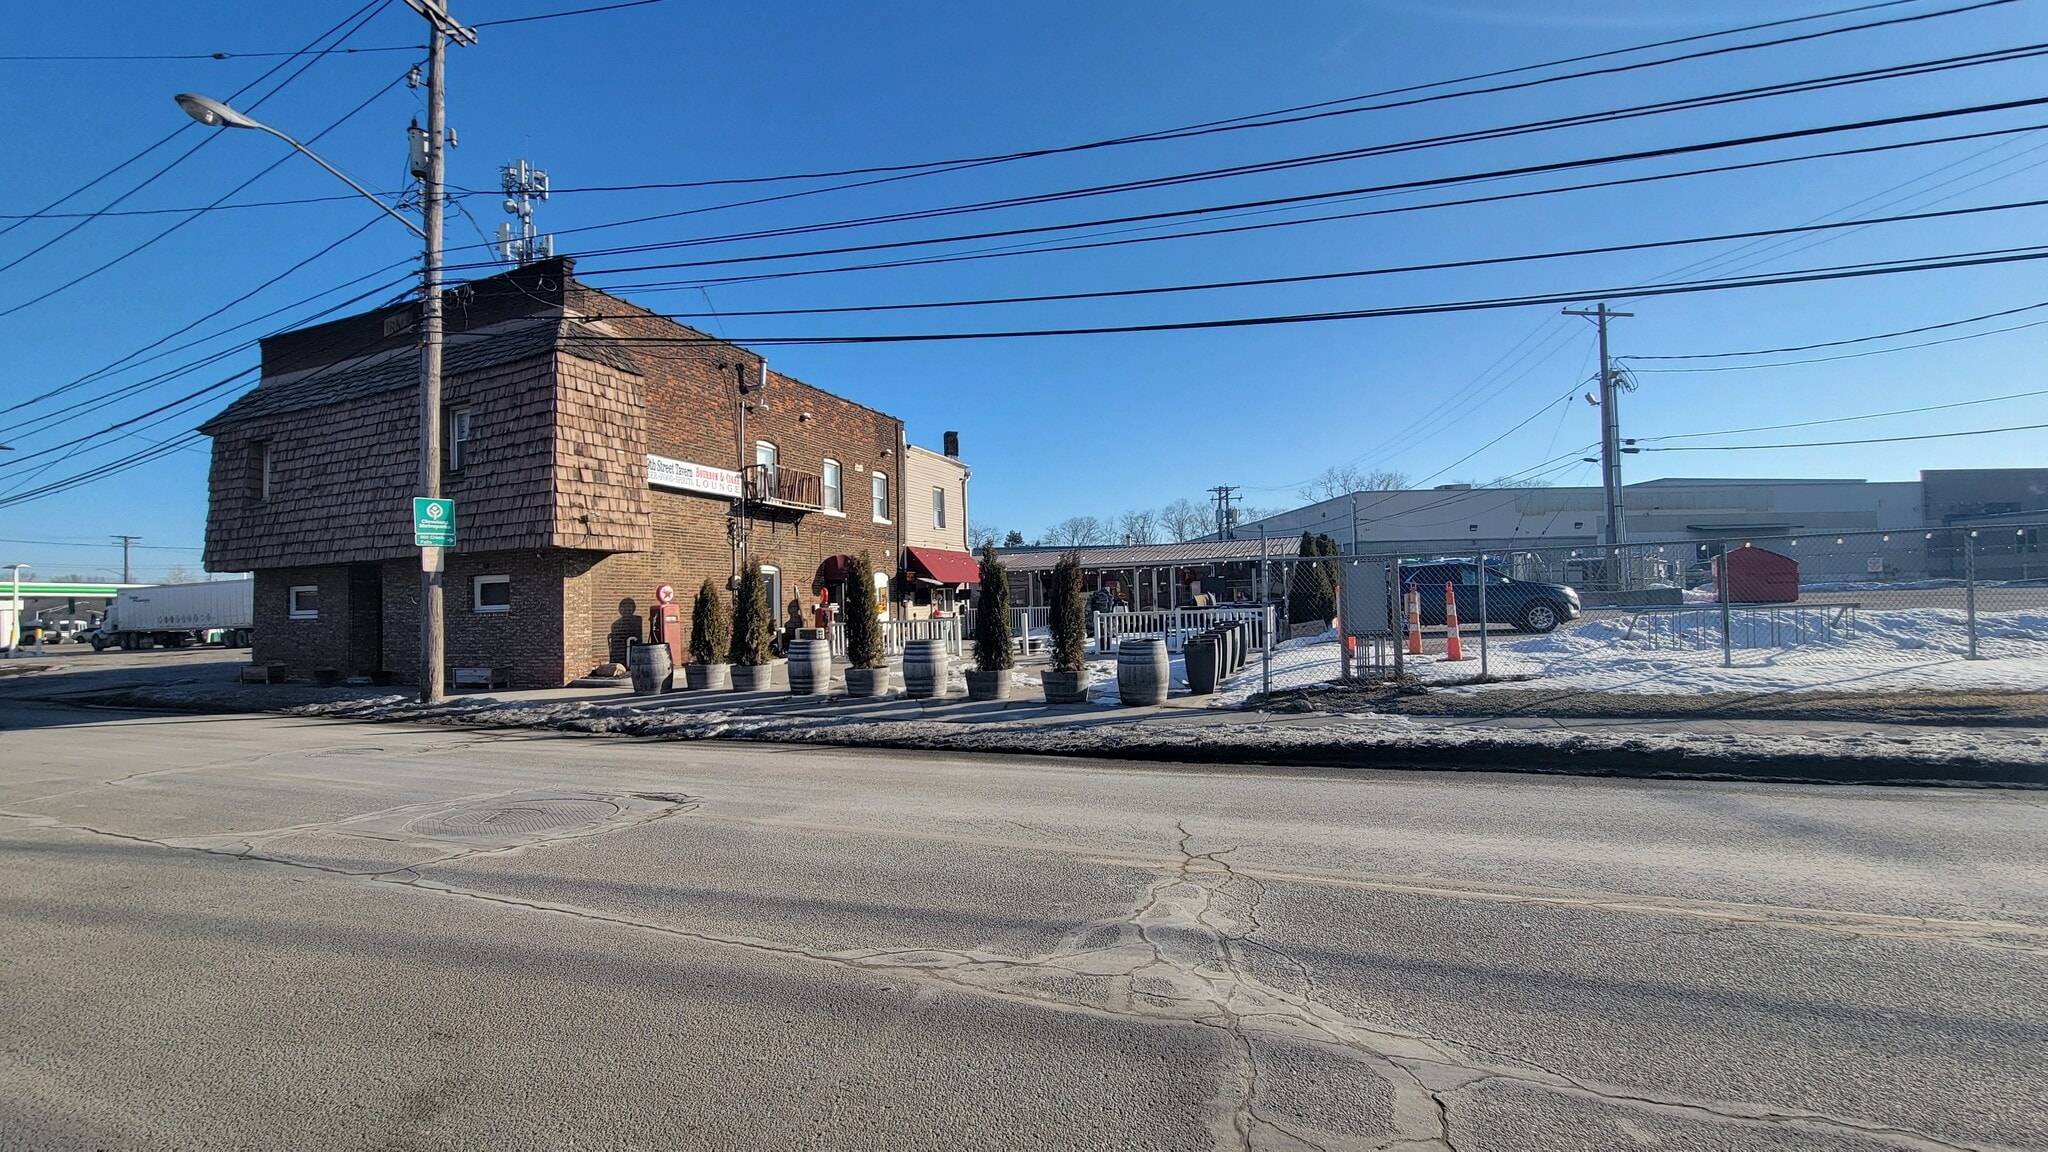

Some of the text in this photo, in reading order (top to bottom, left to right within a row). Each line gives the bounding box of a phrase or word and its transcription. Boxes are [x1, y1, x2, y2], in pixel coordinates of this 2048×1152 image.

[657, 460, 674, 474] Street
[675, 463, 693, 478] Tavern
[720, 472, 725, 481] &
[696, 479, 740, 494] LOUNGE
